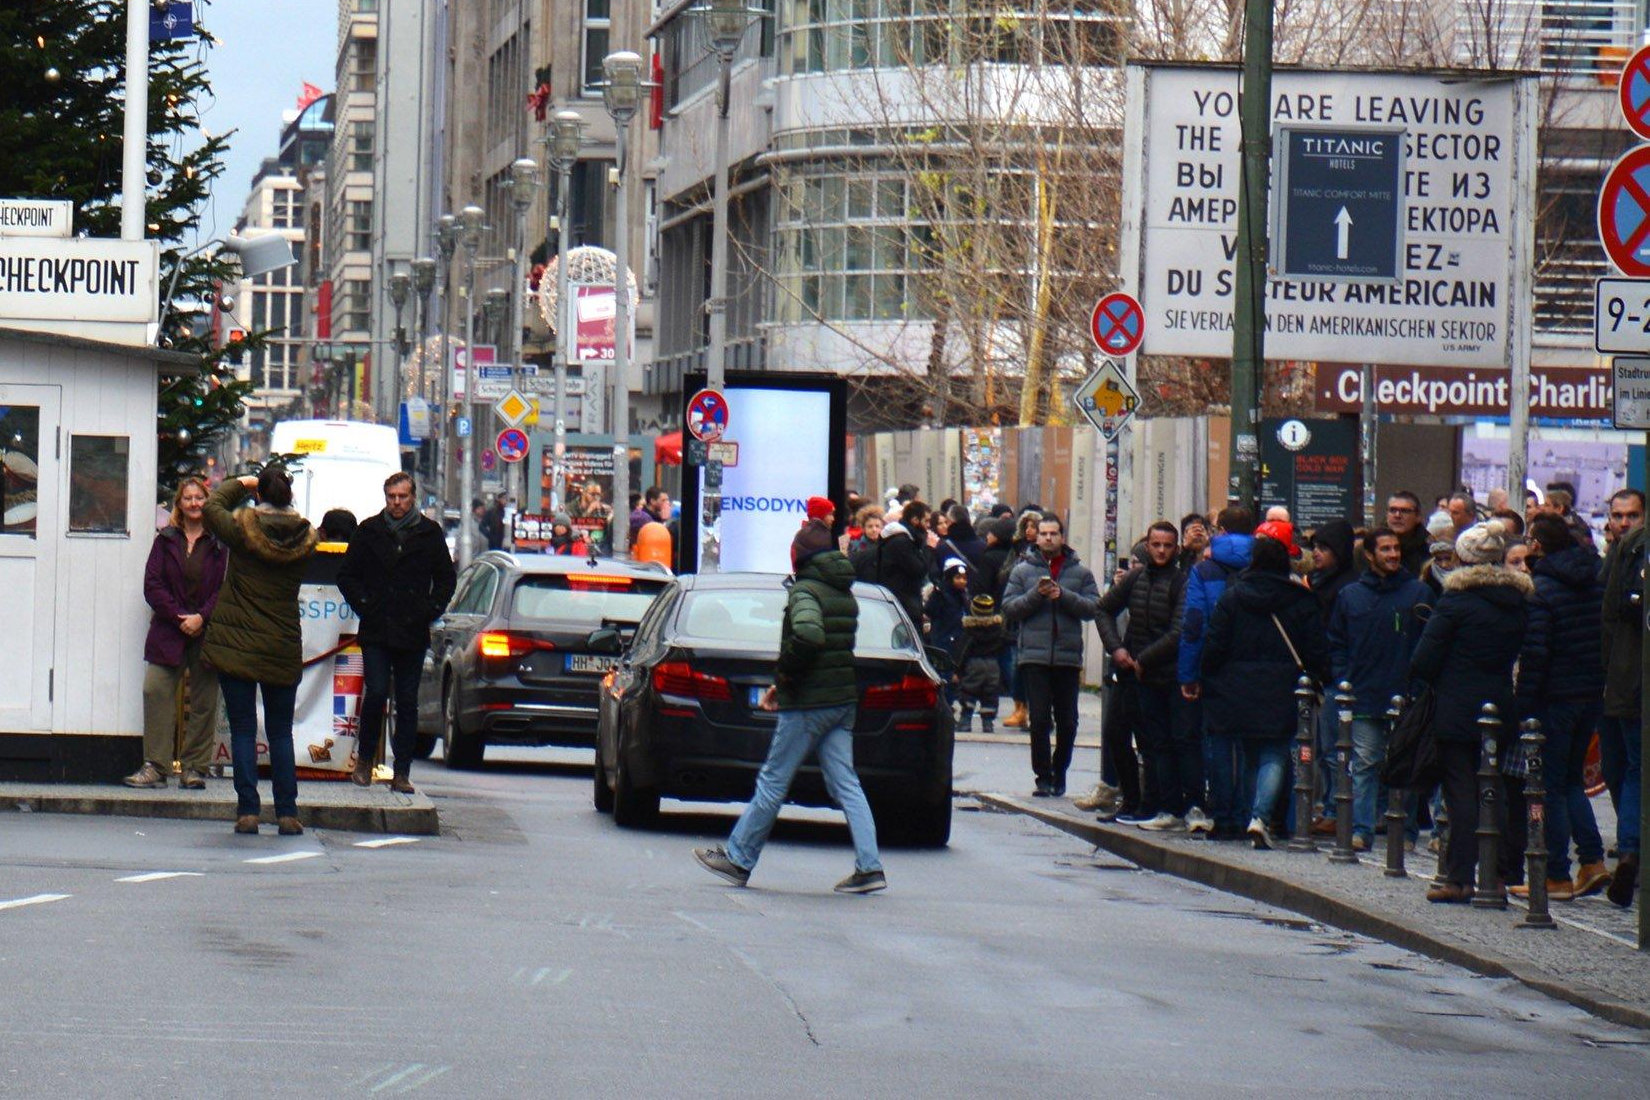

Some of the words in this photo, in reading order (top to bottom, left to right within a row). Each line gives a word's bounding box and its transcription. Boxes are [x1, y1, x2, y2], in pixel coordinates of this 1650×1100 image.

[1193, 90, 1234, 118] YO
[1274, 94, 1333, 121] ARE
[1355, 95, 1485, 126] LEAVING
[1175, 124, 1223, 152] THE
[1303, 138, 1384, 155] TITANIC
[1329, 159, 1356, 170] HOTELS
[1177, 162, 1223, 189] ВЫ
[1293, 188, 1322, 198] TITANIC
[1324, 189, 1367, 200] COMFORT
[1368, 191, 1391, 201] MITTE
[1407, 206, 1500, 234] ЕКТОРА
[1307, 263, 1378, 274] titanic-hotels.com
[1167, 269, 1201, 297] DU
[1344, 279, 1497, 308] AMERICAIN
[1164, 309, 1188, 330] SIE
[1277, 314, 1305, 333] DEN
[1309, 314, 1436, 340] AMERIKANISCHEN
[1441, 320, 1497, 342] SEKTOR
[600, 348, 615, 359] 30
[1458, 343, 1481, 353] ARMY
[1619, 388, 1630, 400] im
[296, 441, 323, 451] Hertz
[721, 496, 808, 513] ENSODYN
[572, 656, 588, 670] HH
